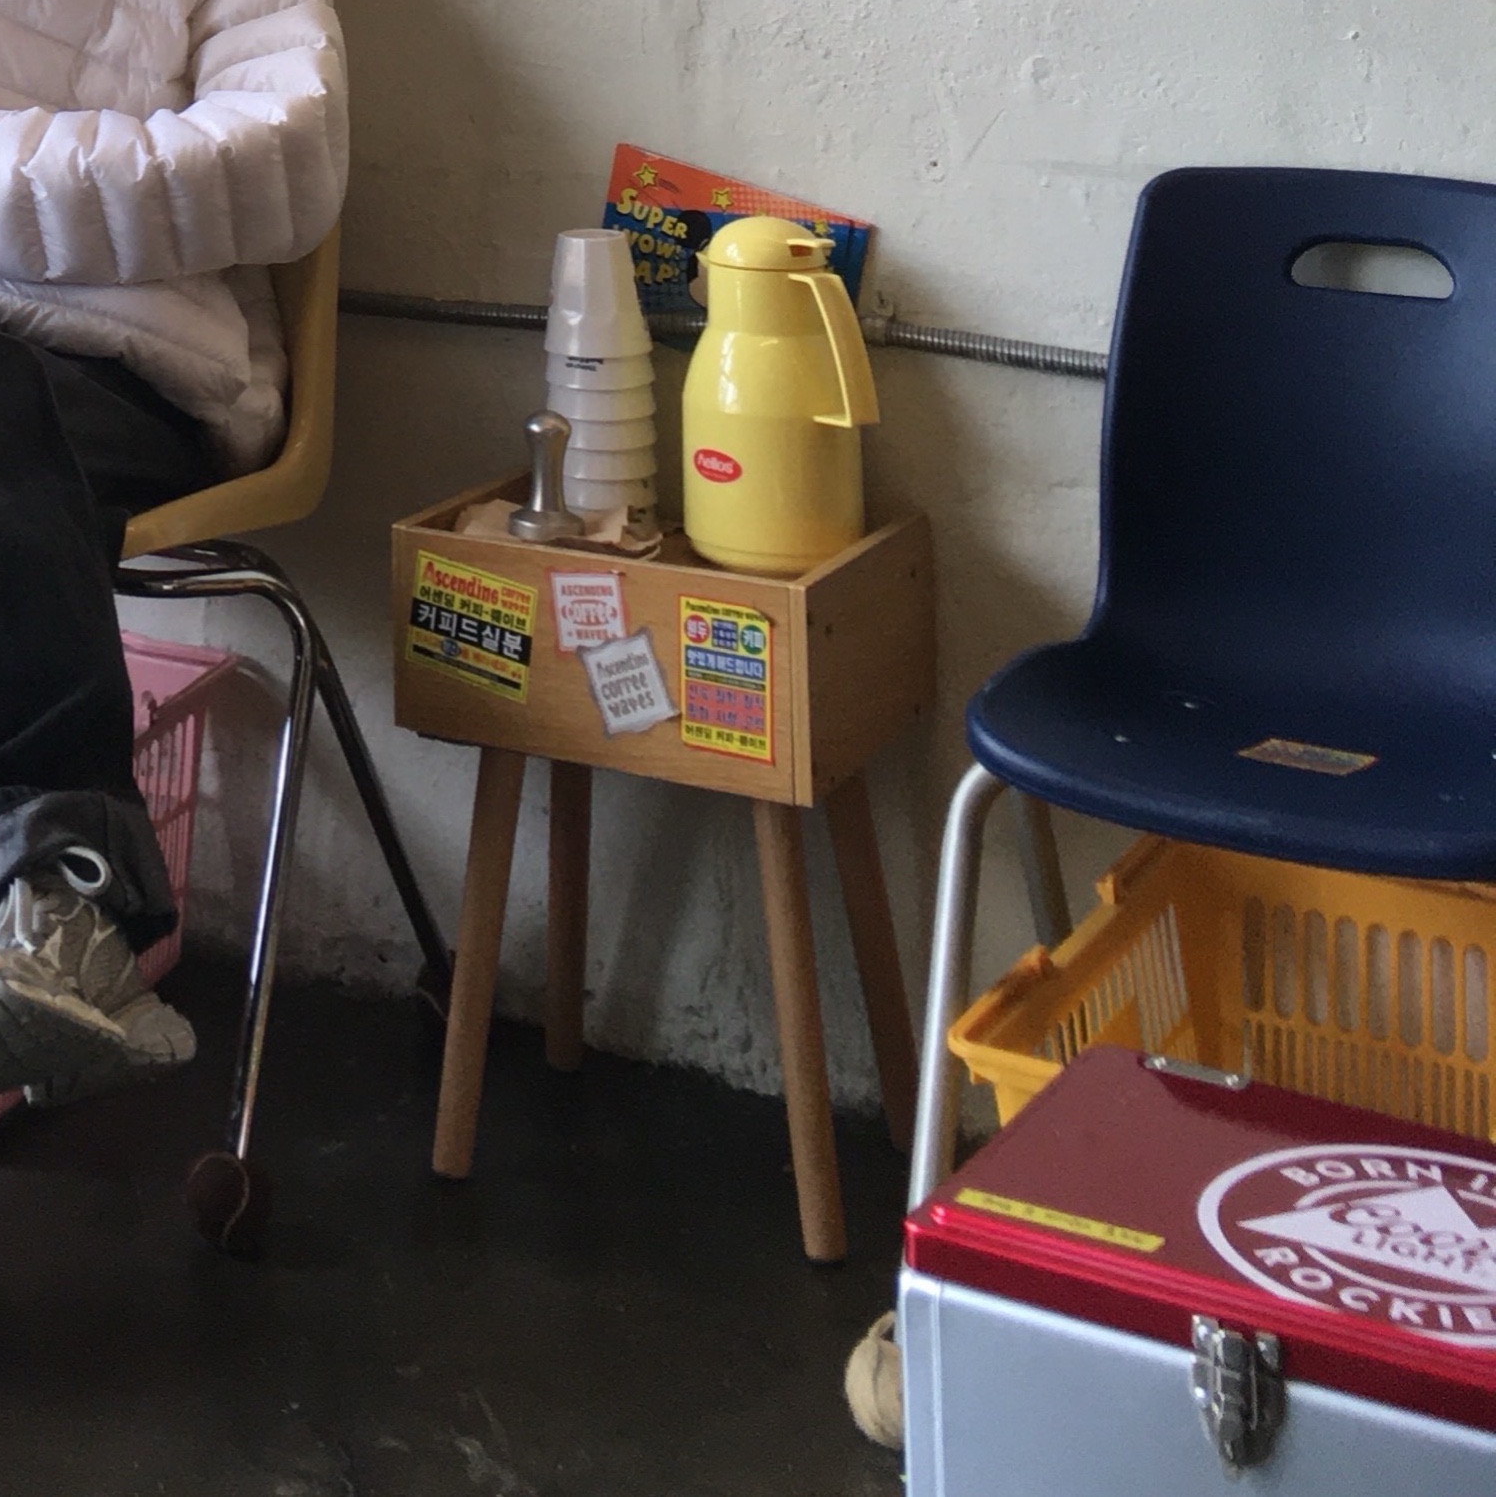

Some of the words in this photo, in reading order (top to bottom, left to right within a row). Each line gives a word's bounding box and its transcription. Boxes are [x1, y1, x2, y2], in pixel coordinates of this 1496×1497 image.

[616, 188, 688, 239] SUPER
[417, 604, 523, 660] 커피드실분
[742, 629, 764, 649] 커피
[1279, 1158, 1444, 1187] BORN
[1469, 1173, 1496, 1197] I
[1255, 1246, 1496, 1333] ROCKIE
